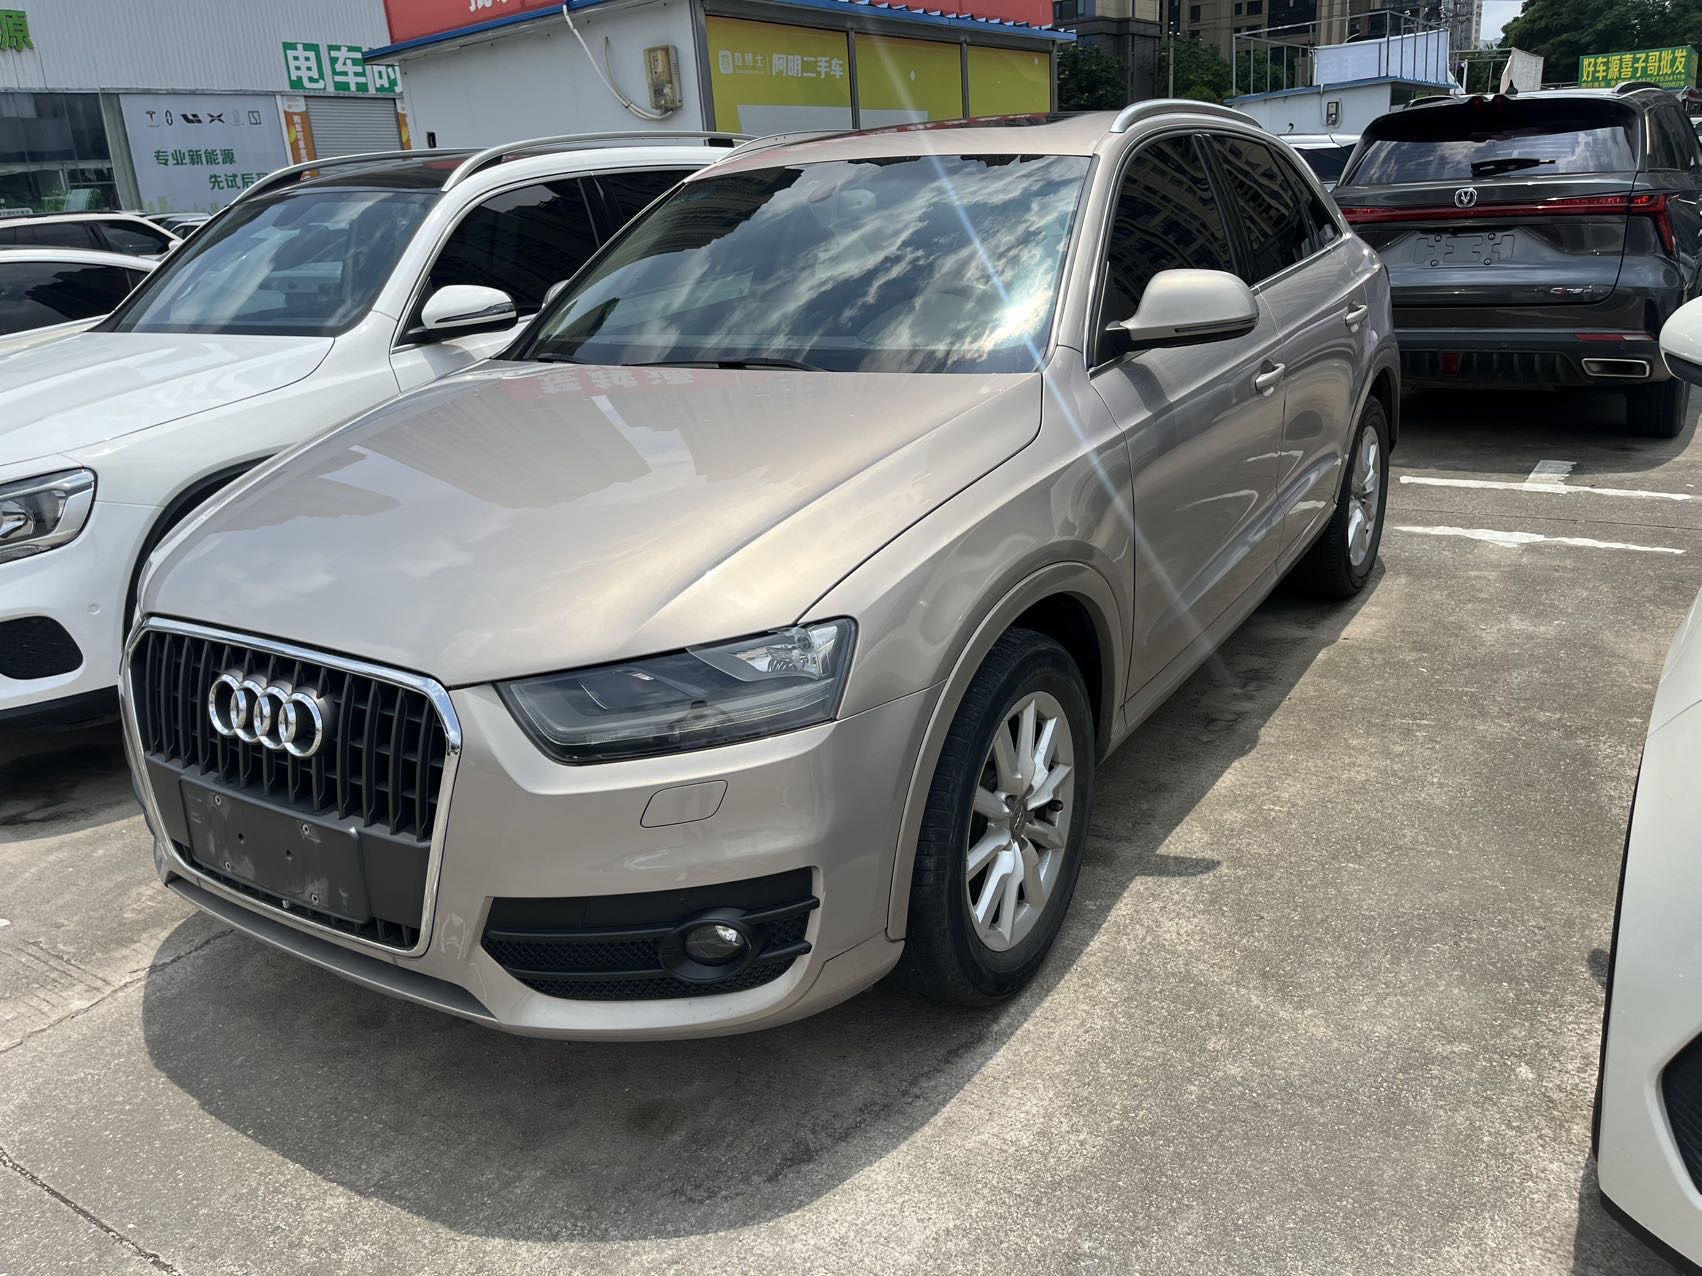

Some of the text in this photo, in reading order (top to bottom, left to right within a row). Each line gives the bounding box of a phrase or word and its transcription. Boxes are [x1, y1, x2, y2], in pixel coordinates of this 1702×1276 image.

[772, 53, 844, 78] 阿明二手车
[1582, 49, 1687, 81] 好车源喜子哥批发
[154, 149, 236, 166] 专业新能源
